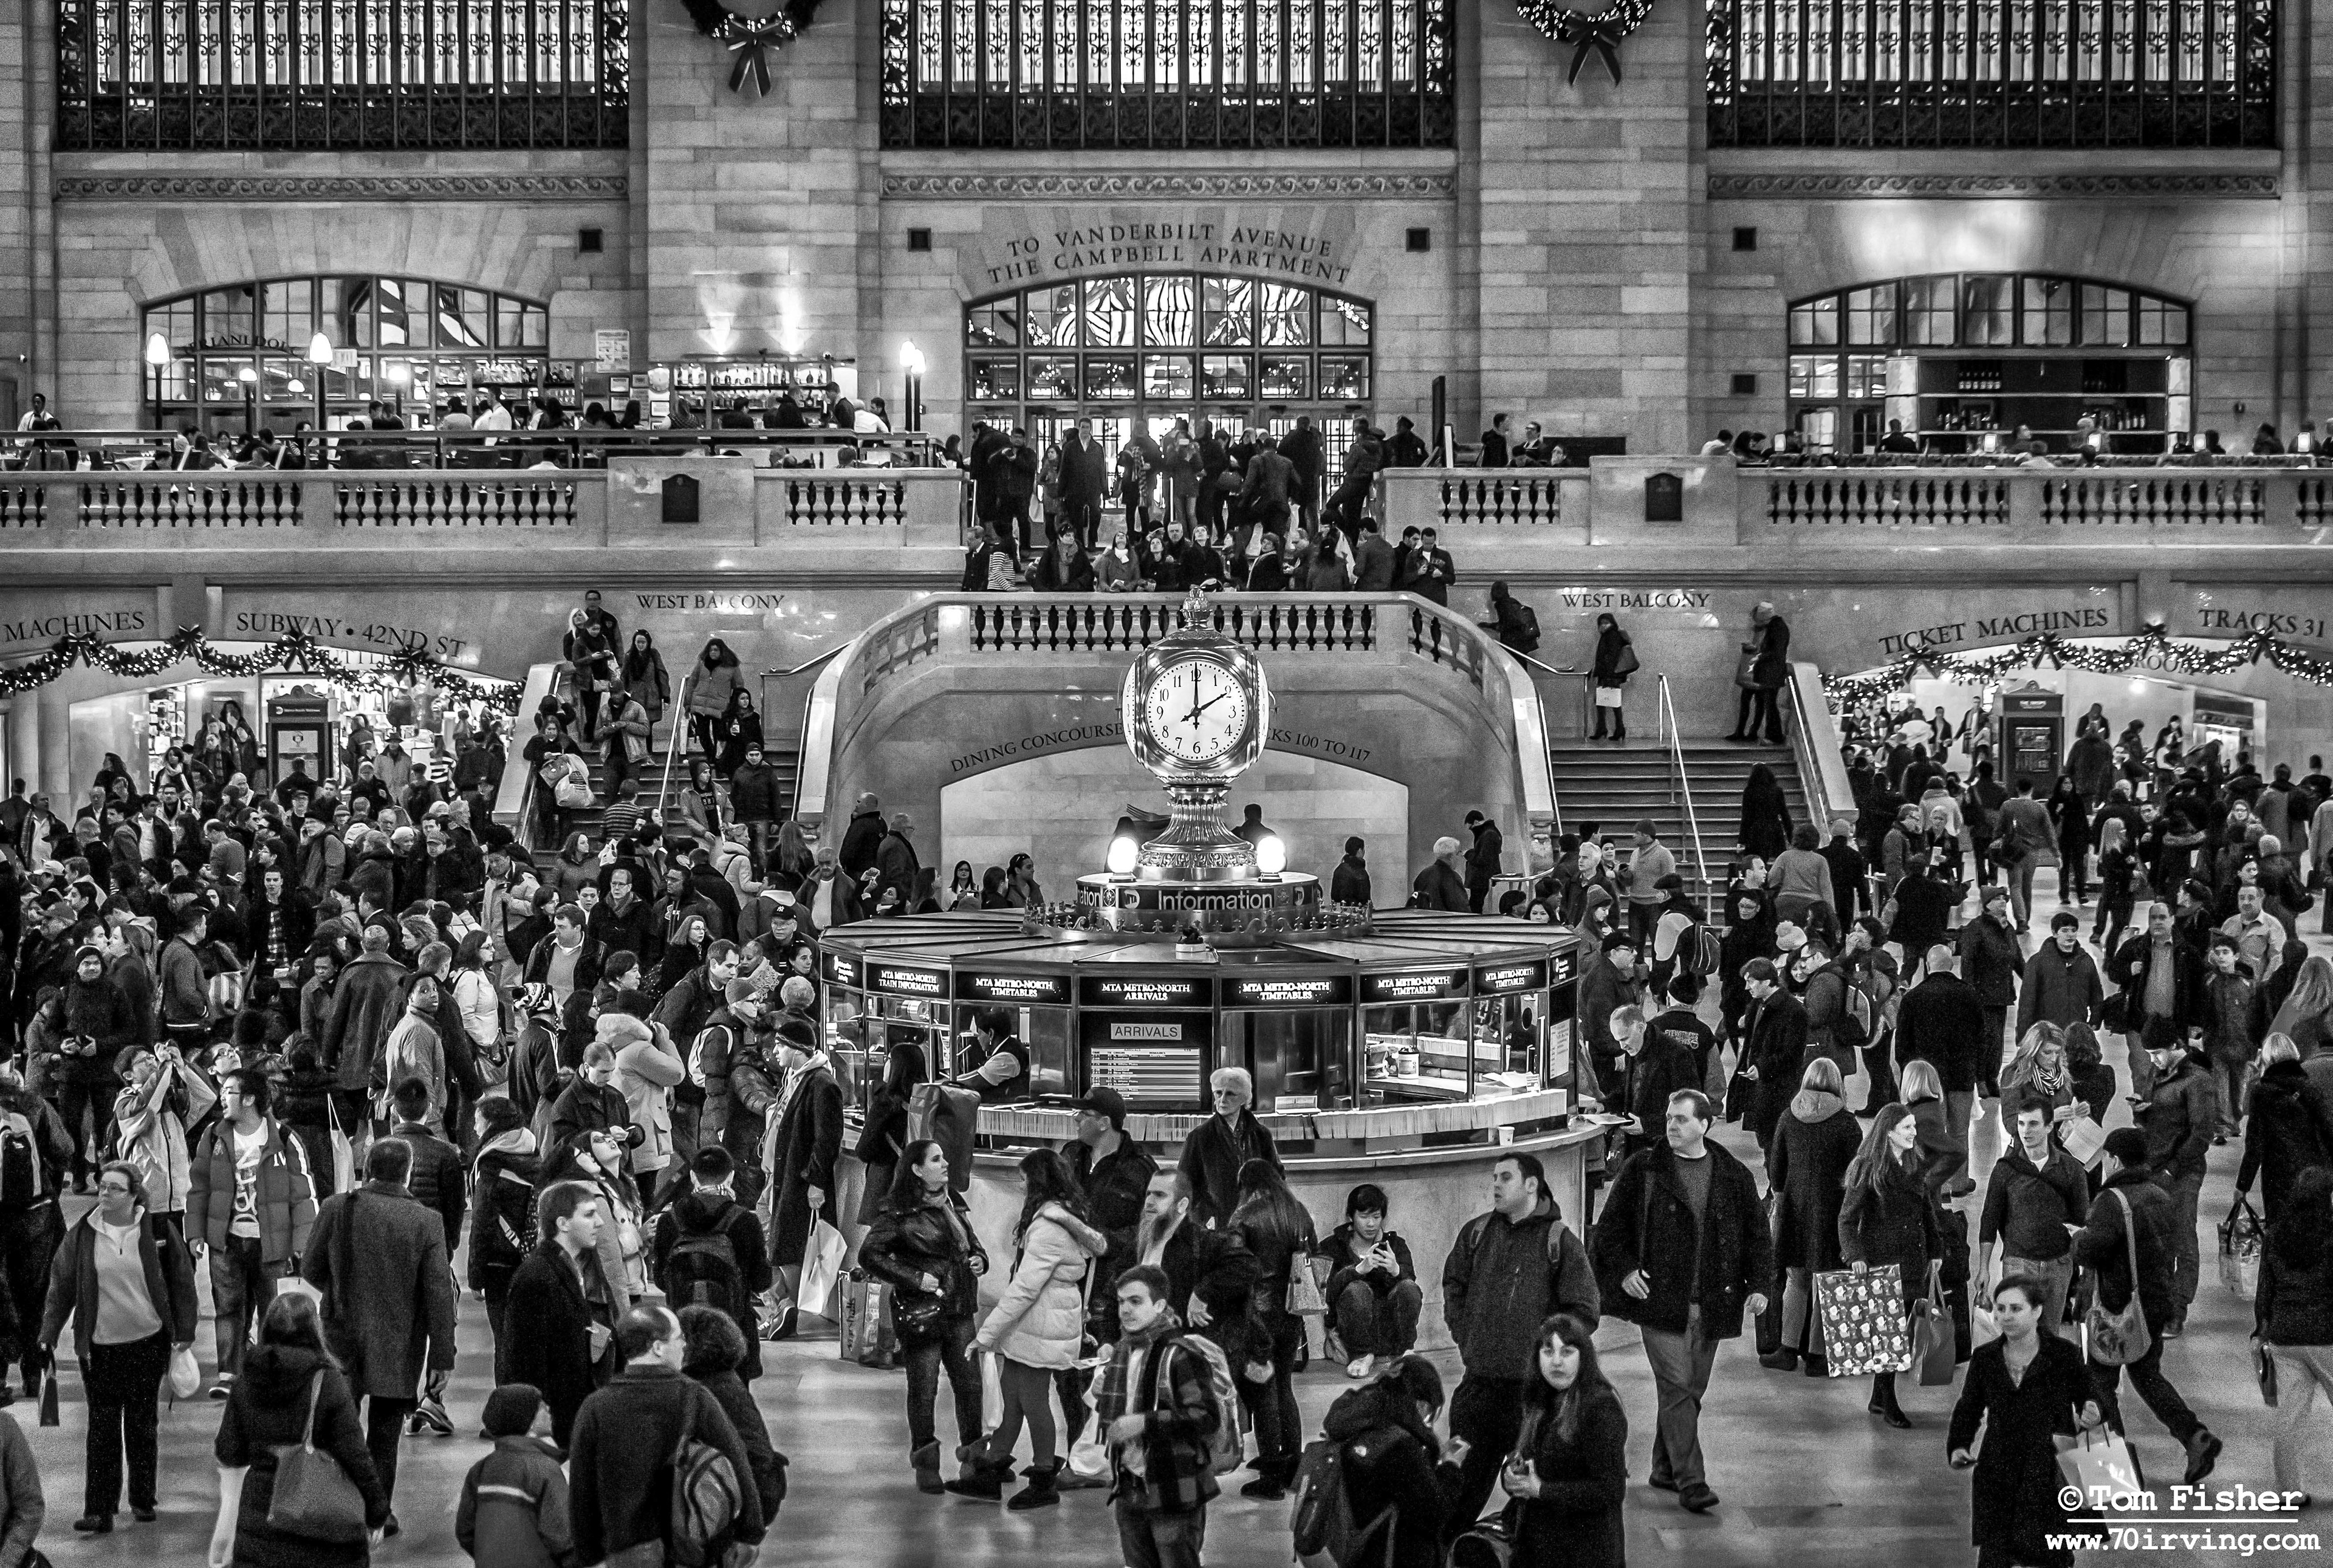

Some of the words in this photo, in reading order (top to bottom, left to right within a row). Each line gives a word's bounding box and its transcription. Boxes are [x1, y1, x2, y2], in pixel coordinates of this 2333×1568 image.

[1007, 237, 1040, 256] TO
[1055, 224, 1214, 247] VANDERBILT
[1232, 225, 1331, 256] AVENUE
[988, 259, 1040, 284] THE
[1054, 246, 1184, 269] CAMPBELL
[1201, 247, 1350, 284] APARTMENT
[637, 595, 688, 608] WEST
[1562, 594, 1614, 608] WEST
[1620, 594, 1710, 608] BALCONY
[3, 611, 145, 642] MACHINES
[2199, 609, 2298, 634] TRACKS
[2303, 620, 2324, 638] 31
[236, 613, 341, 637] SUBWAY
[361, 624, 427, 650] 42ND
[436, 636, 466, 658] ST
[1879, 623, 1965, 654] TICKET
[1977, 608, 2109, 638] MACHINES
[1173, 675, 1182, 687] 11
[1191, 669, 1202, 682] 12
[1213, 674, 1218, 686] 1
[1160, 688, 1169, 702] 10
[1224, 685, 1232, 698] 2
[1157, 706, 1163, 720] 9
[1228, 705, 1236, 718] 3
[1162, 725, 1169, 738] 8
[1224, 724, 1233, 736] 4
[951, 742, 1016, 772] DINING
[1021, 723, 1123, 750] CONCOURSE
[1175, 737, 1182, 749] 7
[1193, 741, 1201, 754] 6
[1210, 738, 1218, 750] 5
[1296, 733, 1318, 748] 100
[1323, 739, 1346, 755] TO
[1349, 747, 1370, 761] 117
[1158, 889, 1272, 910] Information
[882, 970, 894, 979] MTA
[879, 979, 897, 988] TRAIN
[898, 980, 939, 993] INFORMATION
[976, 978, 993, 987] MTA
[995, 979, 1053, 990] METRO-NORTH
[1123, 984, 1190, 992] METRO-NORTH
[1242, 983, 1262, 992] MTA
[1264, 982, 1329, 991] METRO-NORTH
[1378, 979, 1394, 988] MTA
[1396, 976, 1450, 987] METRO-NORTH
[1495, 977, 1525, 988] TIMETABLES
[991, 988, 1038, 998] TIMETABLES
[1125, 992, 1168, 1001] ARRIVALS
[1260, 991, 1312, 1000] TIMETABLES
[1393, 985, 1436, 996] TIMETABLES
[1115, 1026, 1177, 1037] ARRIVALS
